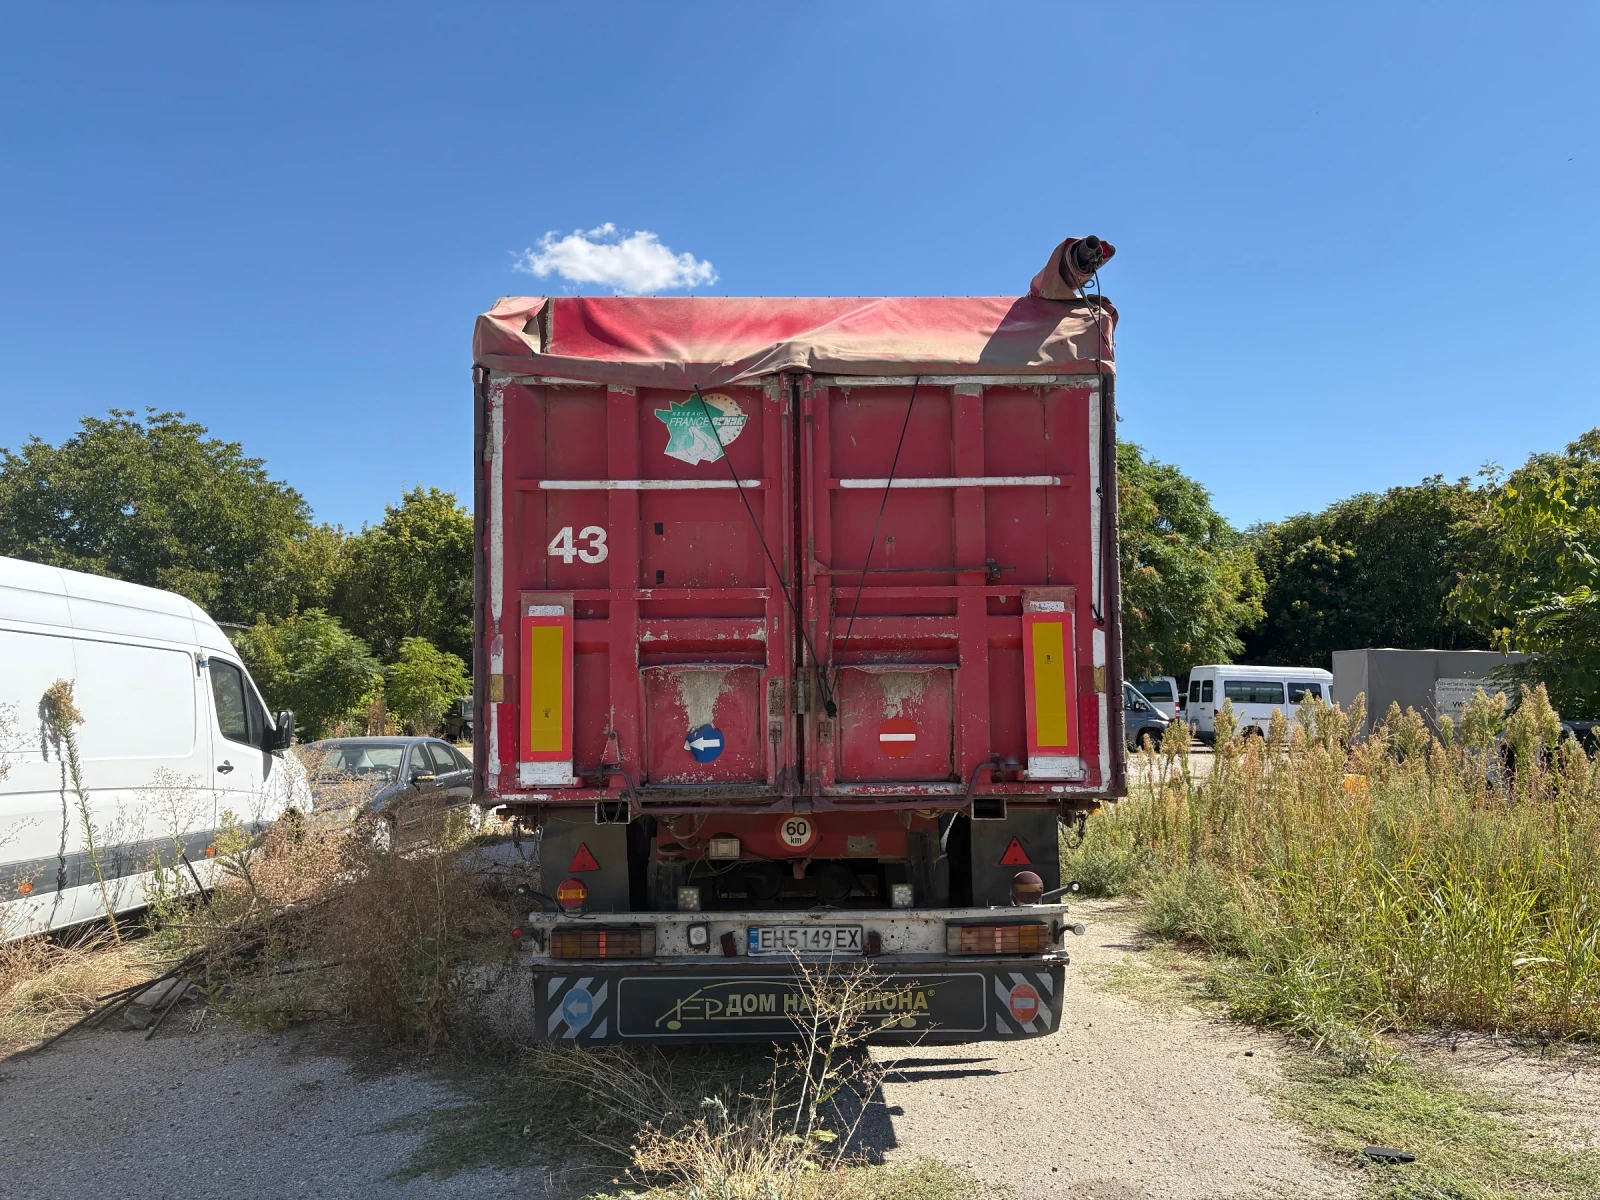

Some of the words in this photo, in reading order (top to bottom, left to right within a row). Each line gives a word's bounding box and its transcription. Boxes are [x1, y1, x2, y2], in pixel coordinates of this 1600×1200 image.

[669, 416, 710, 427] FRANCE
[547, 525, 609, 564] 43
[786, 821, 807, 836] 60
[790, 836, 802, 844] km
[726, 993, 776, 1017] ДОМ
[783, 992, 815, 1012] НА
